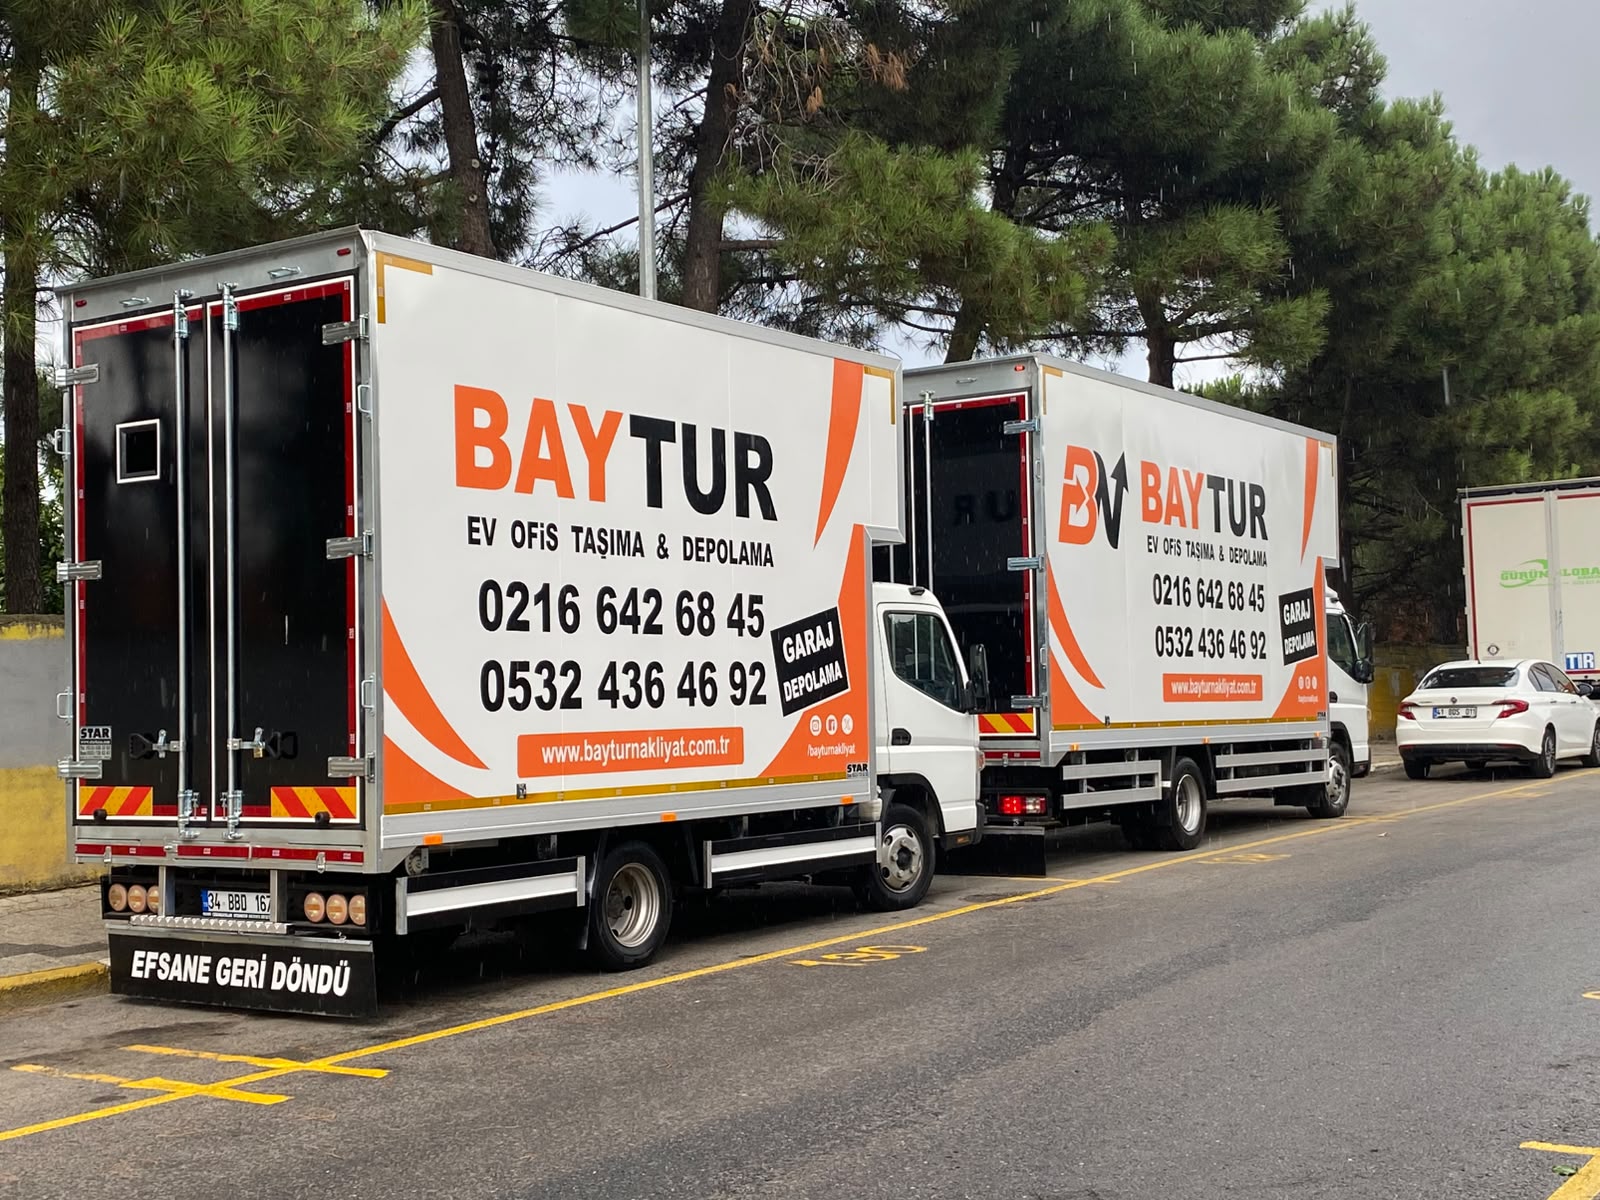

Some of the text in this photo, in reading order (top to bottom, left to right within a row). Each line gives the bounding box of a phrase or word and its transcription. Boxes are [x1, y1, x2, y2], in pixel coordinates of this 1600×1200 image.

[454, 384, 778, 522] BAYTUR
[1140, 460, 1269, 541] BAYTUR
[467, 515, 497, 546] EV
[571, 525, 645, 559] TAŞIMA
[656, 533, 669, 560] &
[683, 535, 774, 568] DEPOLAMA
[1147, 535, 1158, 553] EV
[1185, 540, 1215, 562] TAŞIMA
[1219, 545, 1225, 561] &
[1229, 546, 1267, 567] DEPOLAMA
[479, 579, 764, 638] 0216 642 68 45
[1153, 573, 1265, 613] 0216 642 68 45
[1283, 598, 1311, 625] GARAJ
[782, 621, 834, 663] GARAJ
[1155, 625, 1267, 660] 0532 436 46 92
[1284, 630, 1315, 655] DEPOLAMA
[1566, 653, 1594, 669] TIR
[480, 659, 767, 712] 0532 436 46 92
[783, 660, 843, 702] DEPOLAMA
[80, 728, 110, 739] STAR
[541, 737, 731, 769] www.bayturnakliyat.com.tr
[807, 743, 856, 760] /bayturnakliyat
[847, 763, 868, 773] STAR
[207, 892, 221, 910] 34
[131, 950, 351, 997] EFSANE GERİ DÖNDÜ
